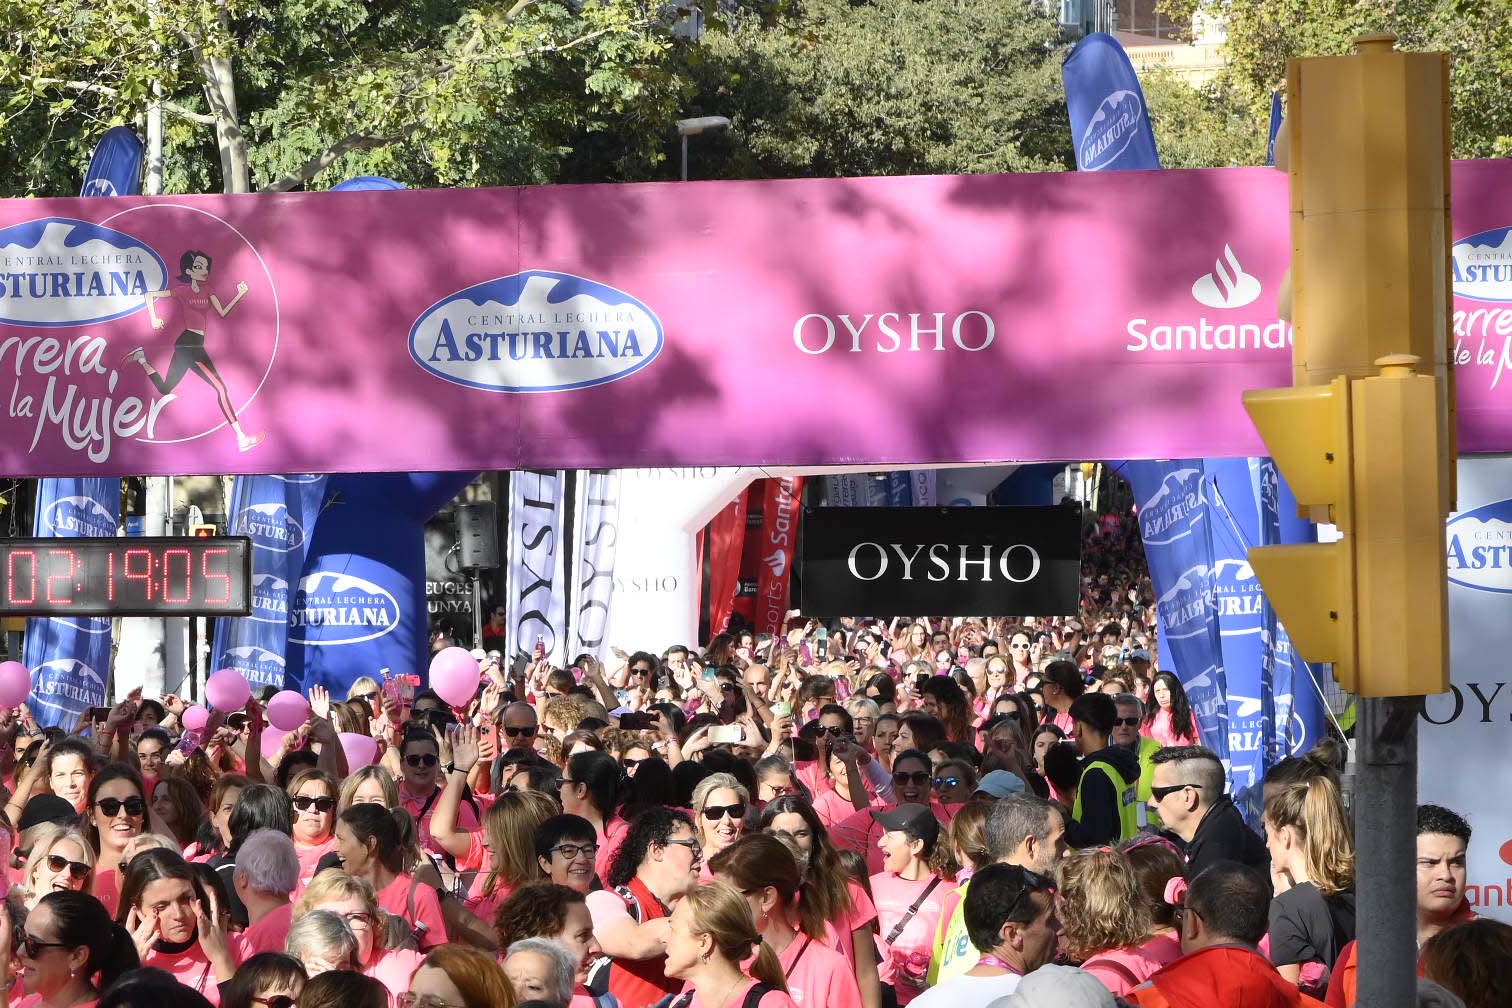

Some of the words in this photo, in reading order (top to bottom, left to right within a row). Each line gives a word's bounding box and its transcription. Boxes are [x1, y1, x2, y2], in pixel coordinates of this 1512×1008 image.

[71, 253, 144, 266] LECHERA
[467, 313, 548, 327] CENTRAL
[554, 310, 636, 325] LECHERA
[792, 309, 995, 354] OYSHO
[428, 316, 643, 363] ASTURIANA
[1476, 339, 1494, 366] la
[9, 377, 34, 418] la
[29, 370, 177, 463] Mujer
[7, 549, 231, 604] 02:19:05
[847, 541, 1041, 583] OYSHO
[337, 596, 386, 605] LECHERA
[33, 672, 104, 708] ASTURIANA
